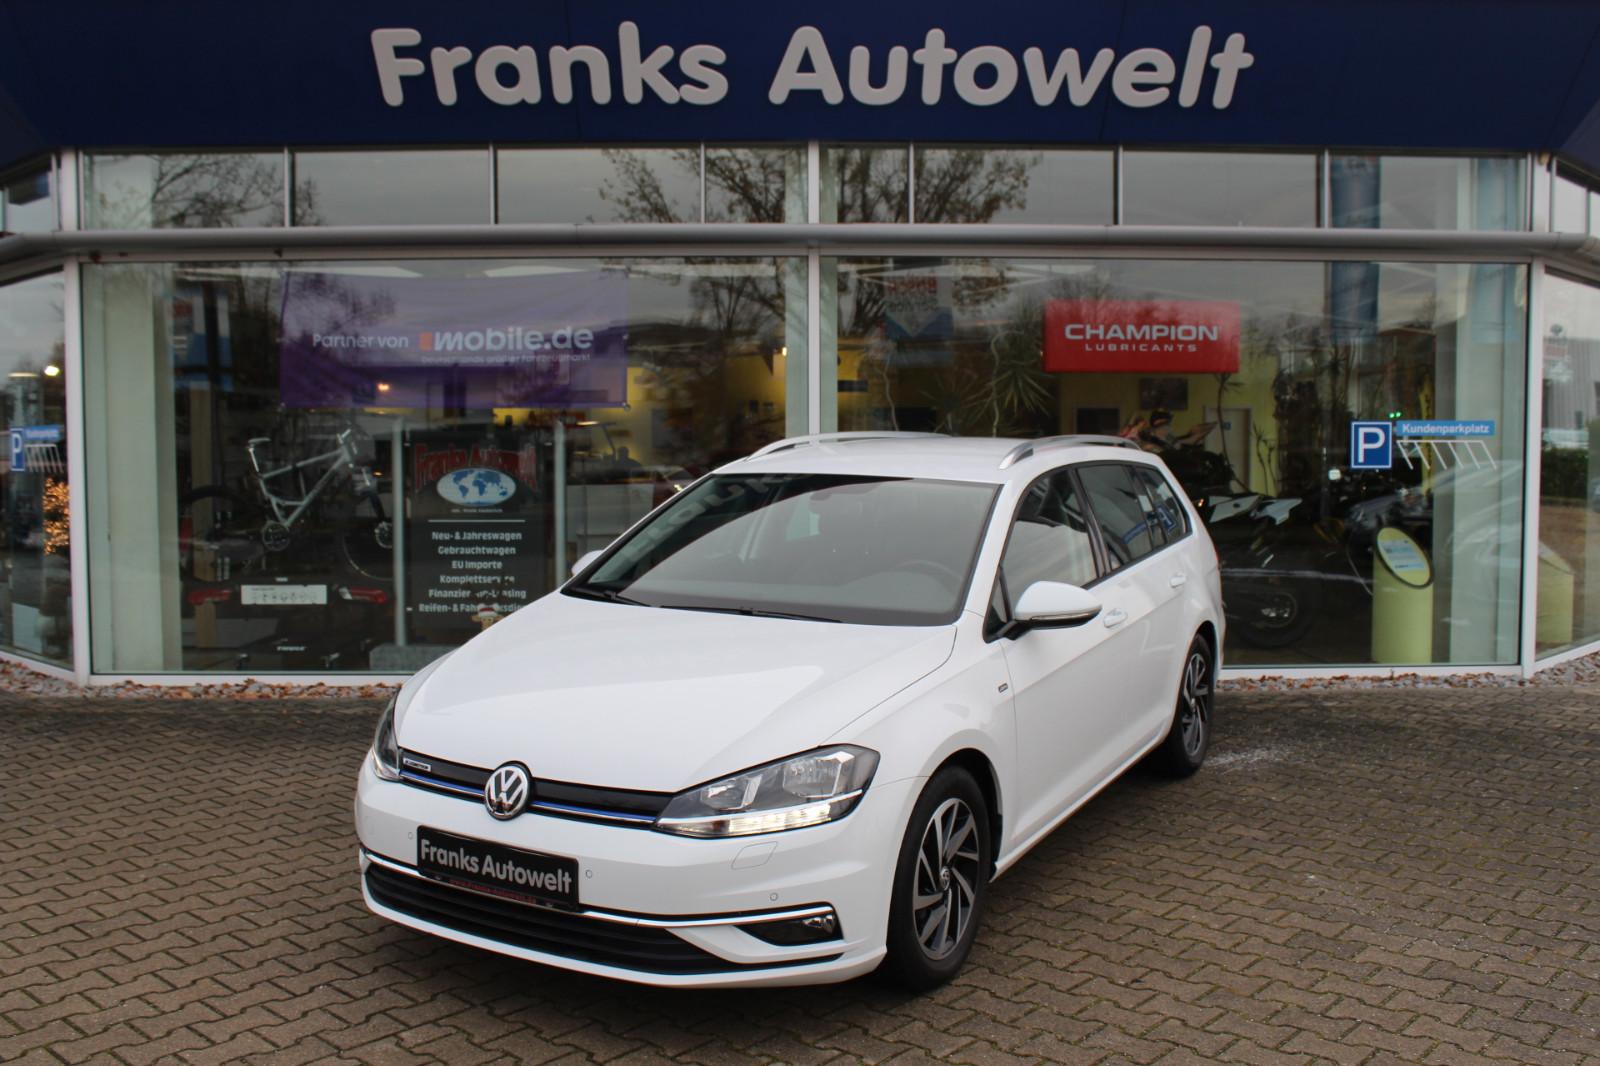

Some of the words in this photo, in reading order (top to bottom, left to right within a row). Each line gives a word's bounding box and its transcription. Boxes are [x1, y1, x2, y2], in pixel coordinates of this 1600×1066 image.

[371, 21, 729, 107] Franks
[768, 25, 1255, 110] Autowelt
[1064, 323, 1219, 341] CHAMPION
[312, 333, 374, 349] Partner
[376, 336, 409, 349] von
[434, 327, 594, 351] mobile.de
[1085, 343, 1197, 352] LUBRICANTS
[1357, 427, 1386, 463] P
[1402, 423, 1490, 434] Kundenparkplatz
[432, 532, 453, 540] Neu-
[454, 532, 461, 540] &
[462, 531, 522, 542] Jahreswagen
[438, 546, 516, 556] Gebrauchtwagen
[452, 561, 464, 569] EU
[465, 560, 503, 570] Importe
[440, 575, 515, 585] Komplettservce
[419, 604, 451, 612] Reifen-
[421, 839, 480, 874] Franks
[481, 854, 572, 894] Autowelt
